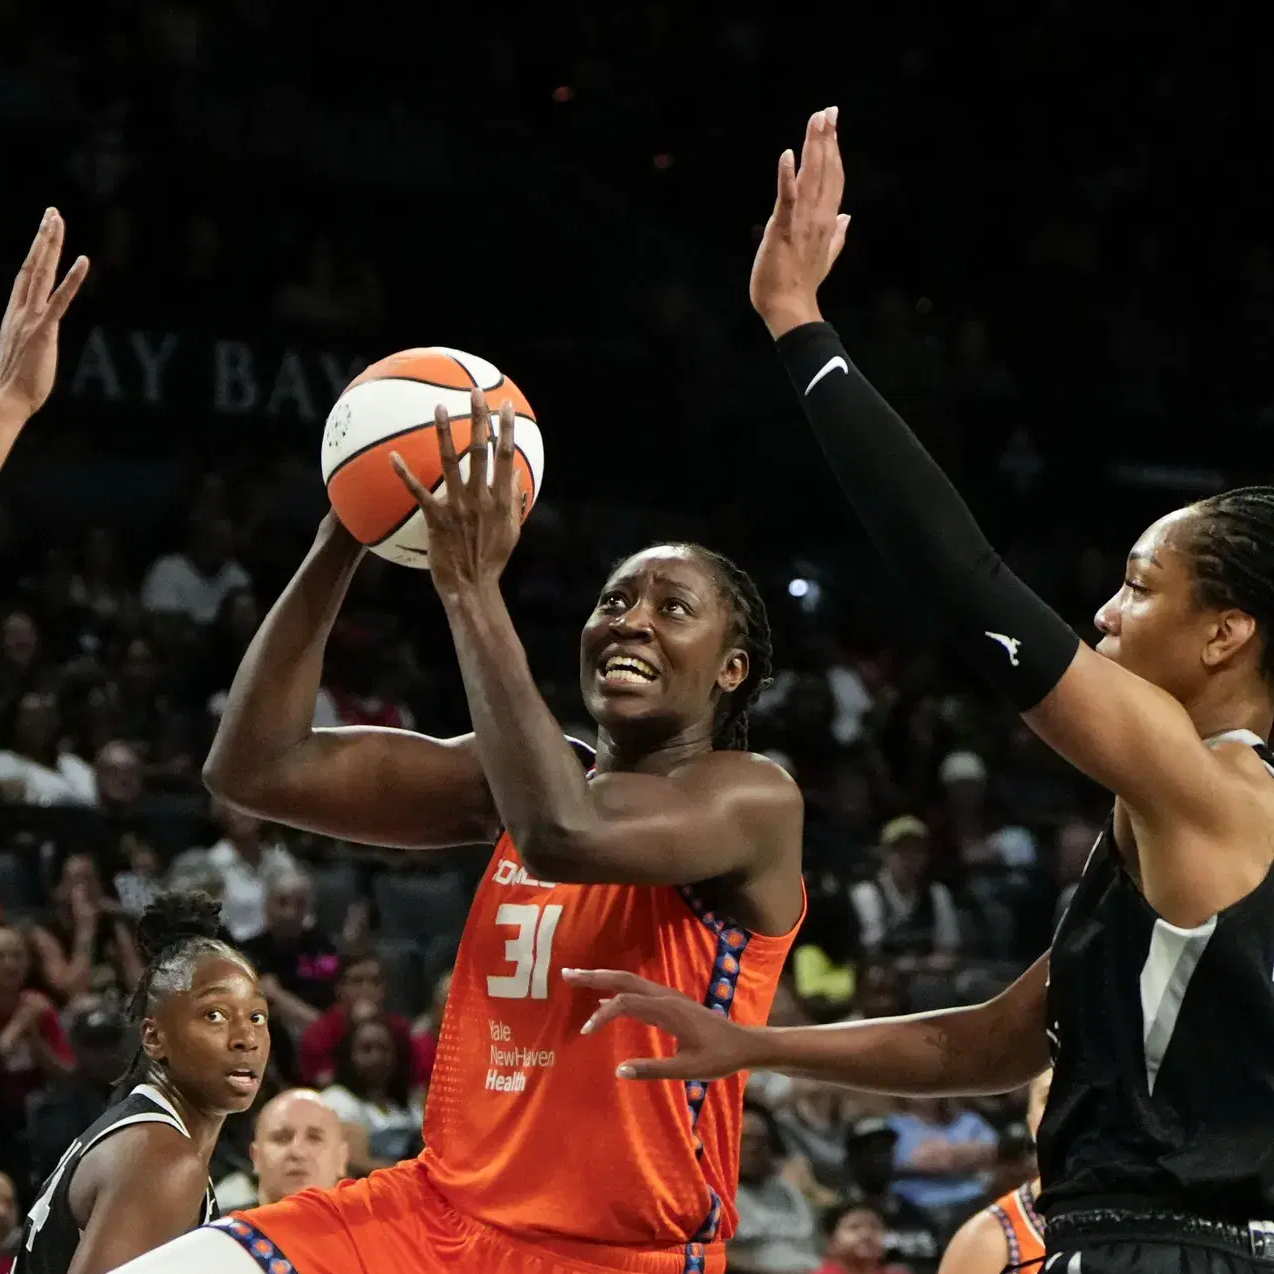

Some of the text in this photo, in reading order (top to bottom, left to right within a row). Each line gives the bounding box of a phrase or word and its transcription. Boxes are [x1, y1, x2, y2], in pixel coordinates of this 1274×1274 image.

[486, 904, 563, 999] 31
[488, 1019, 511, 1041] Yale
[485, 1069, 526, 1092] Health
